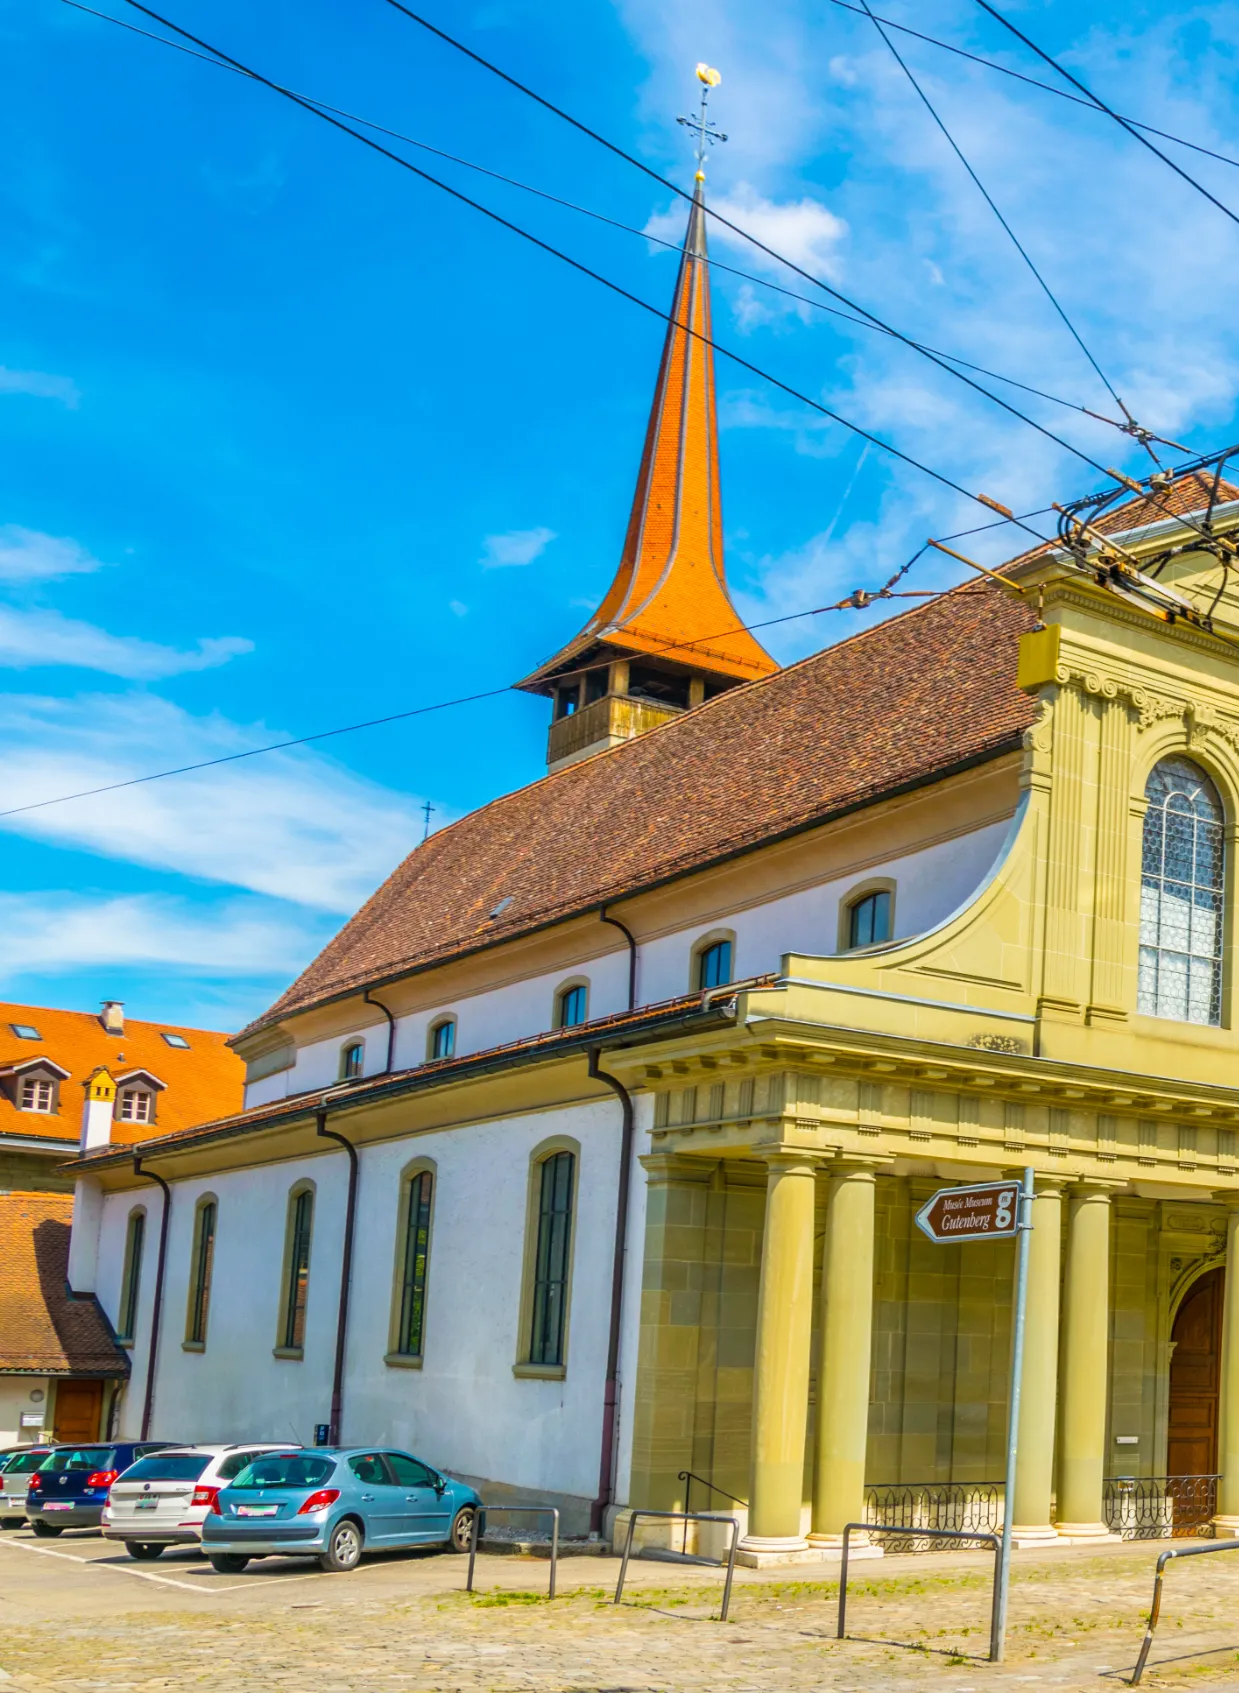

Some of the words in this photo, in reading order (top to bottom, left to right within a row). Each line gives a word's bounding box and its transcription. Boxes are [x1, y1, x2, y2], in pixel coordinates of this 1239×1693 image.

[942, 1198, 964, 1210] Musée
[964, 1197, 993, 1208] Museum
[941, 1211, 992, 1231] Gutenberg
